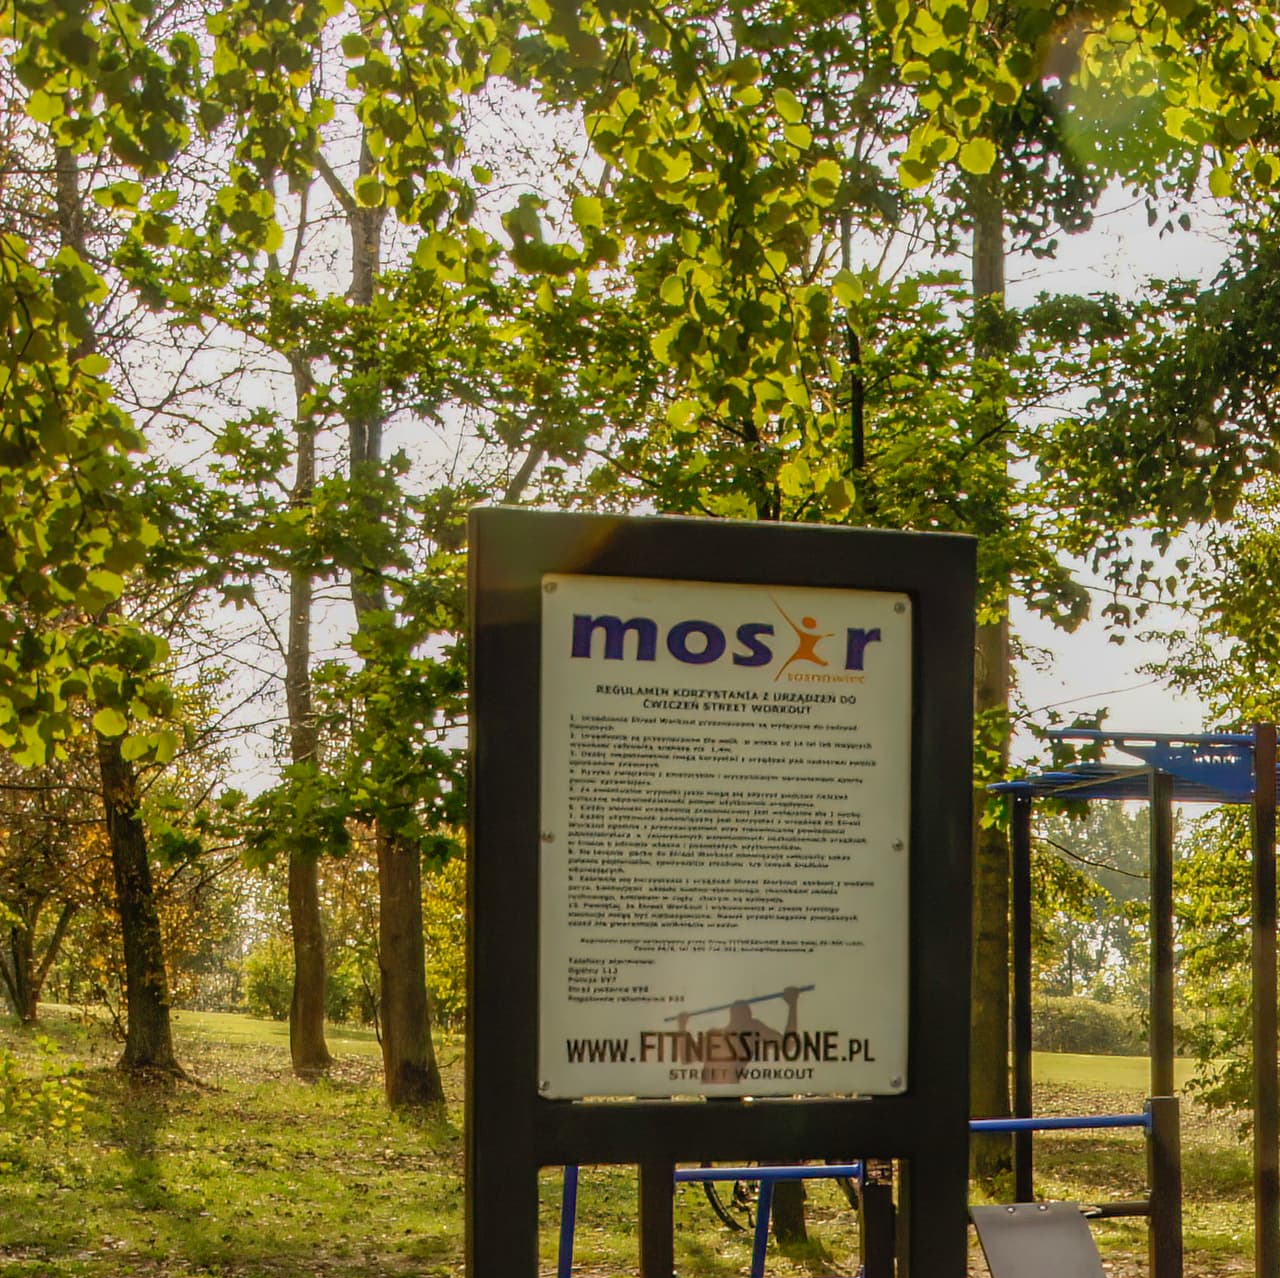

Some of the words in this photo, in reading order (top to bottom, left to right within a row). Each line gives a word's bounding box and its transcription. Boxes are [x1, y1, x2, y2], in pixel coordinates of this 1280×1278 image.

[596, 684, 669, 696] REGULAMIN
[673, 688, 759, 701] KORZYSTANIA
[839, 695, 857, 705] DO
[703, 701, 746, 713] STREET
[751, 704, 813, 715] WORKOUT
[669, 1068, 728, 1080] STREET
[735, 1067, 814, 1080] WORKOUT
